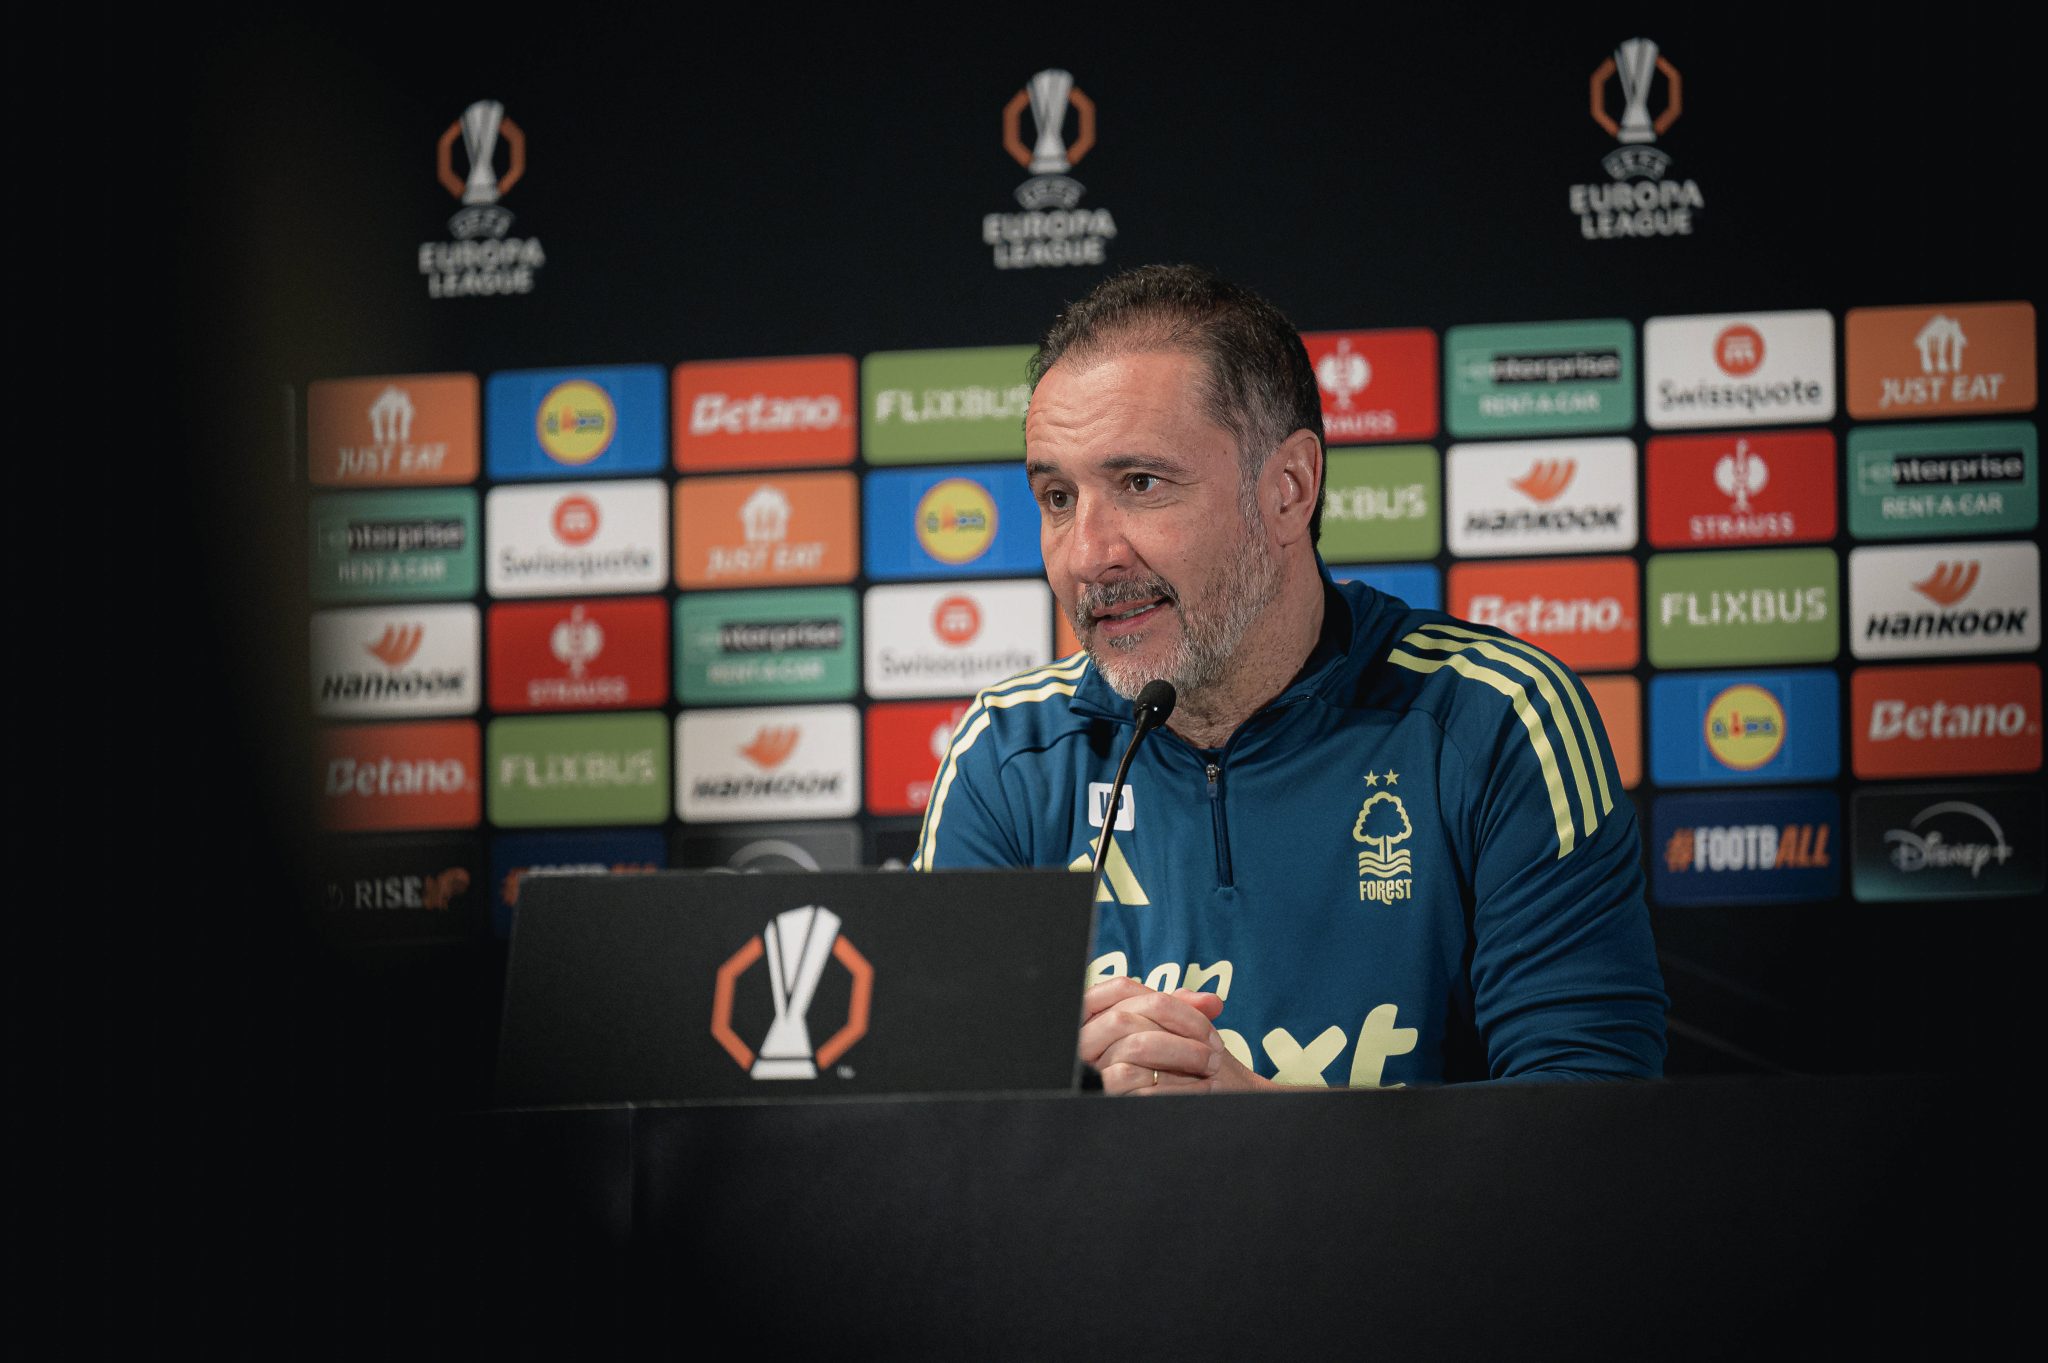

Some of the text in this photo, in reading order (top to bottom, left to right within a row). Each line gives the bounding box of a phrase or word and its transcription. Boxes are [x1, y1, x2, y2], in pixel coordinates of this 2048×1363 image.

[1569, 179, 1704, 215] EUROPA
[982, 208, 1117, 244] EUROPA
[1580, 208, 1692, 239] LEAGUE
[418, 237, 546, 274] EUROPA
[994, 238, 1106, 269] LEAGUE
[429, 266, 534, 299] LEAGUE
[1659, 377, 1822, 413] Swissquote
[1879, 373, 2005, 408] JUST EAT
[337, 441, 448, 479] JUST EAT
[1689, 512, 1795, 541] STRAUSS
[707, 546, 770, 580] JUST
[1883, 828, 2014, 879] Disney+
